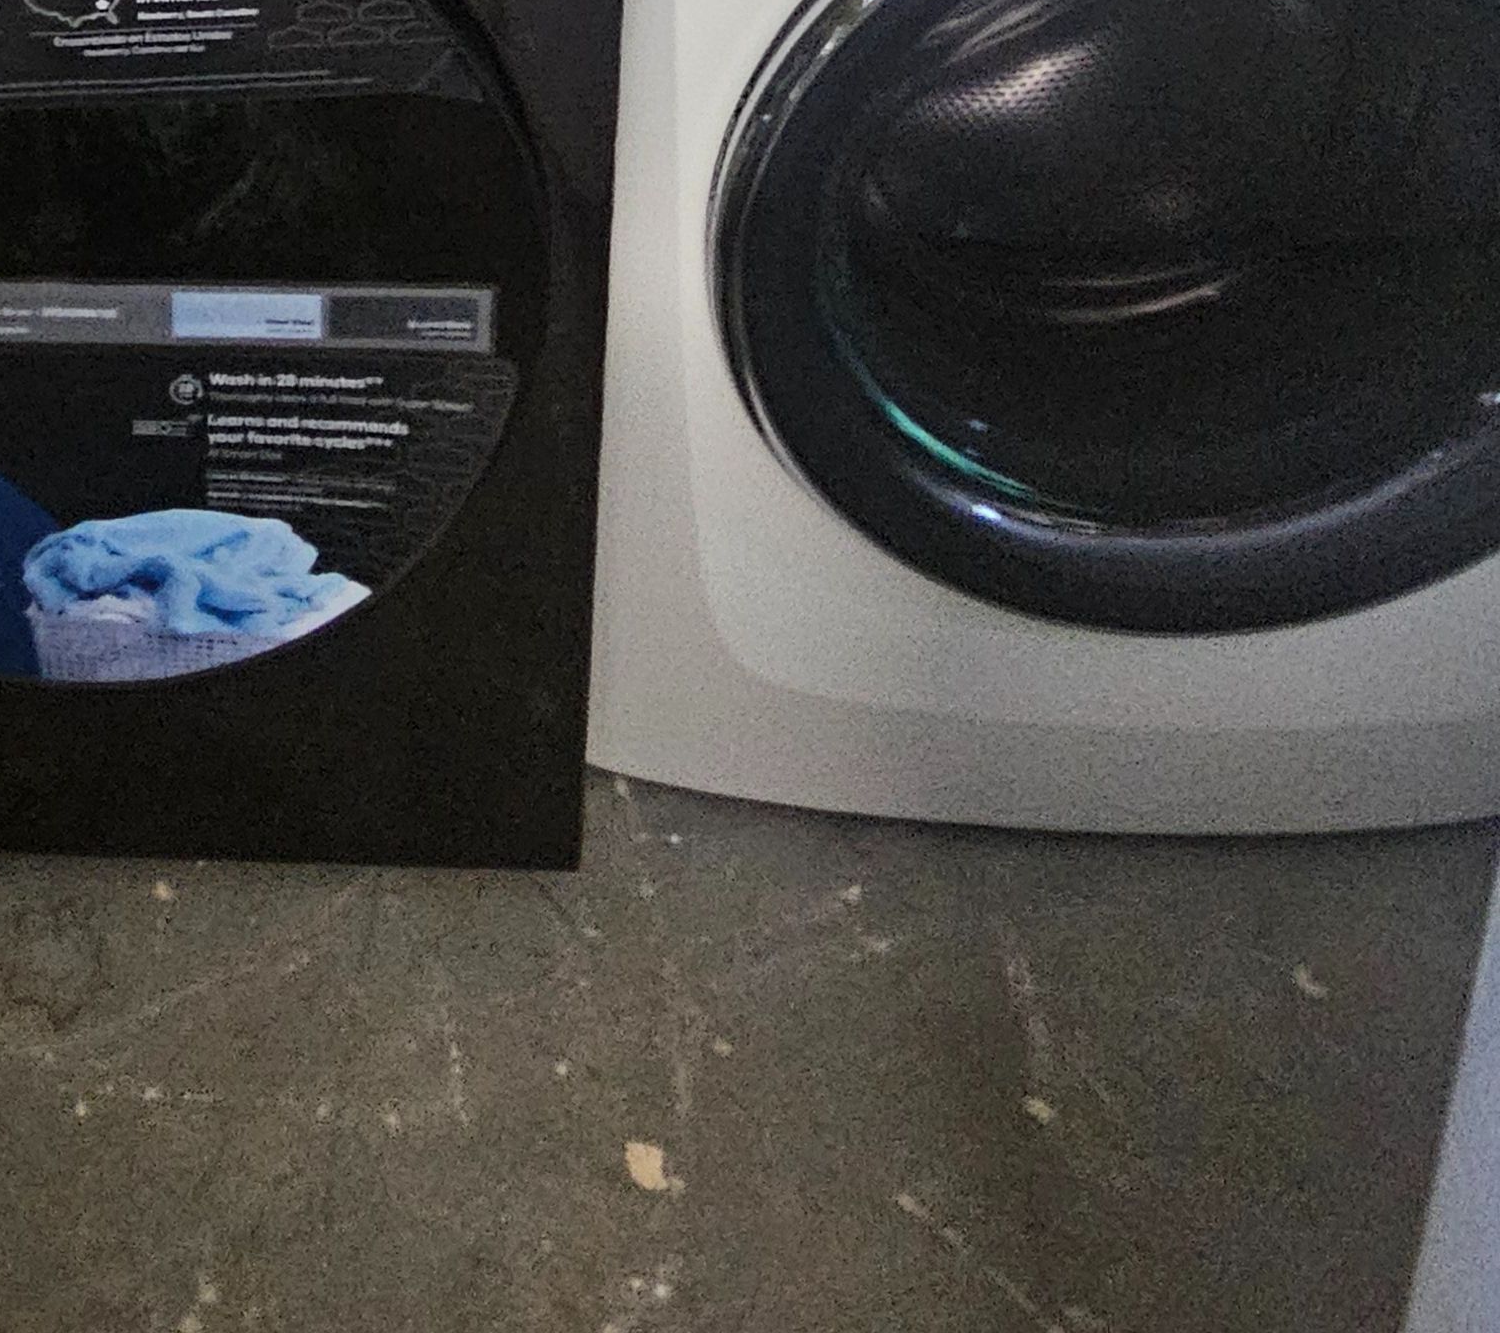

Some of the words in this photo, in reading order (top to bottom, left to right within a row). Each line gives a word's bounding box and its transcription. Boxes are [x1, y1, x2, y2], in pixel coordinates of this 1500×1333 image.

[209, 372, 256, 387] Wash
[256, 373, 273, 386] in
[207, 414, 265, 428] Learns
[265, 416, 300, 429] and
[300, 419, 409, 436] recommends
[207, 433, 245, 446] your
[246, 430, 313, 447] favorite
